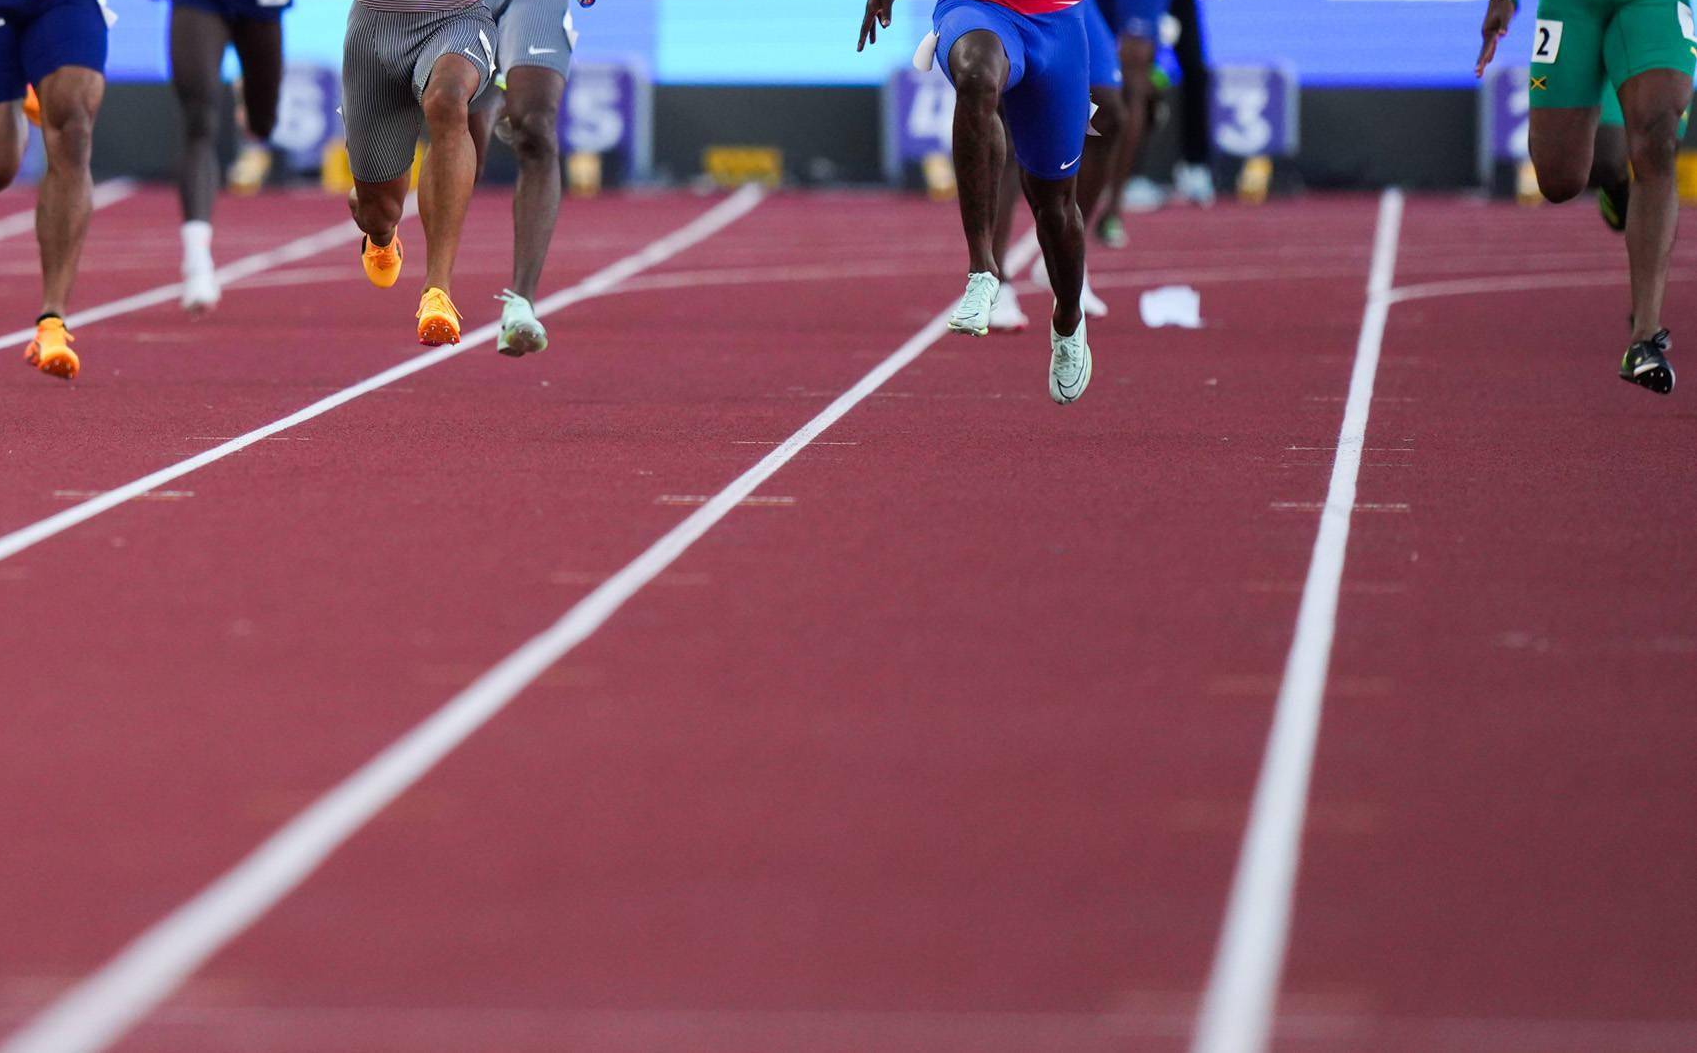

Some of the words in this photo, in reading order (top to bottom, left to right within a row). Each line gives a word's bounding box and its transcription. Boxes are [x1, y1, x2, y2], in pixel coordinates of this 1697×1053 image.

[1536, 27, 1550, 56] 2
[567, 83, 624, 151] 5
[1214, 82, 1273, 156] 3
